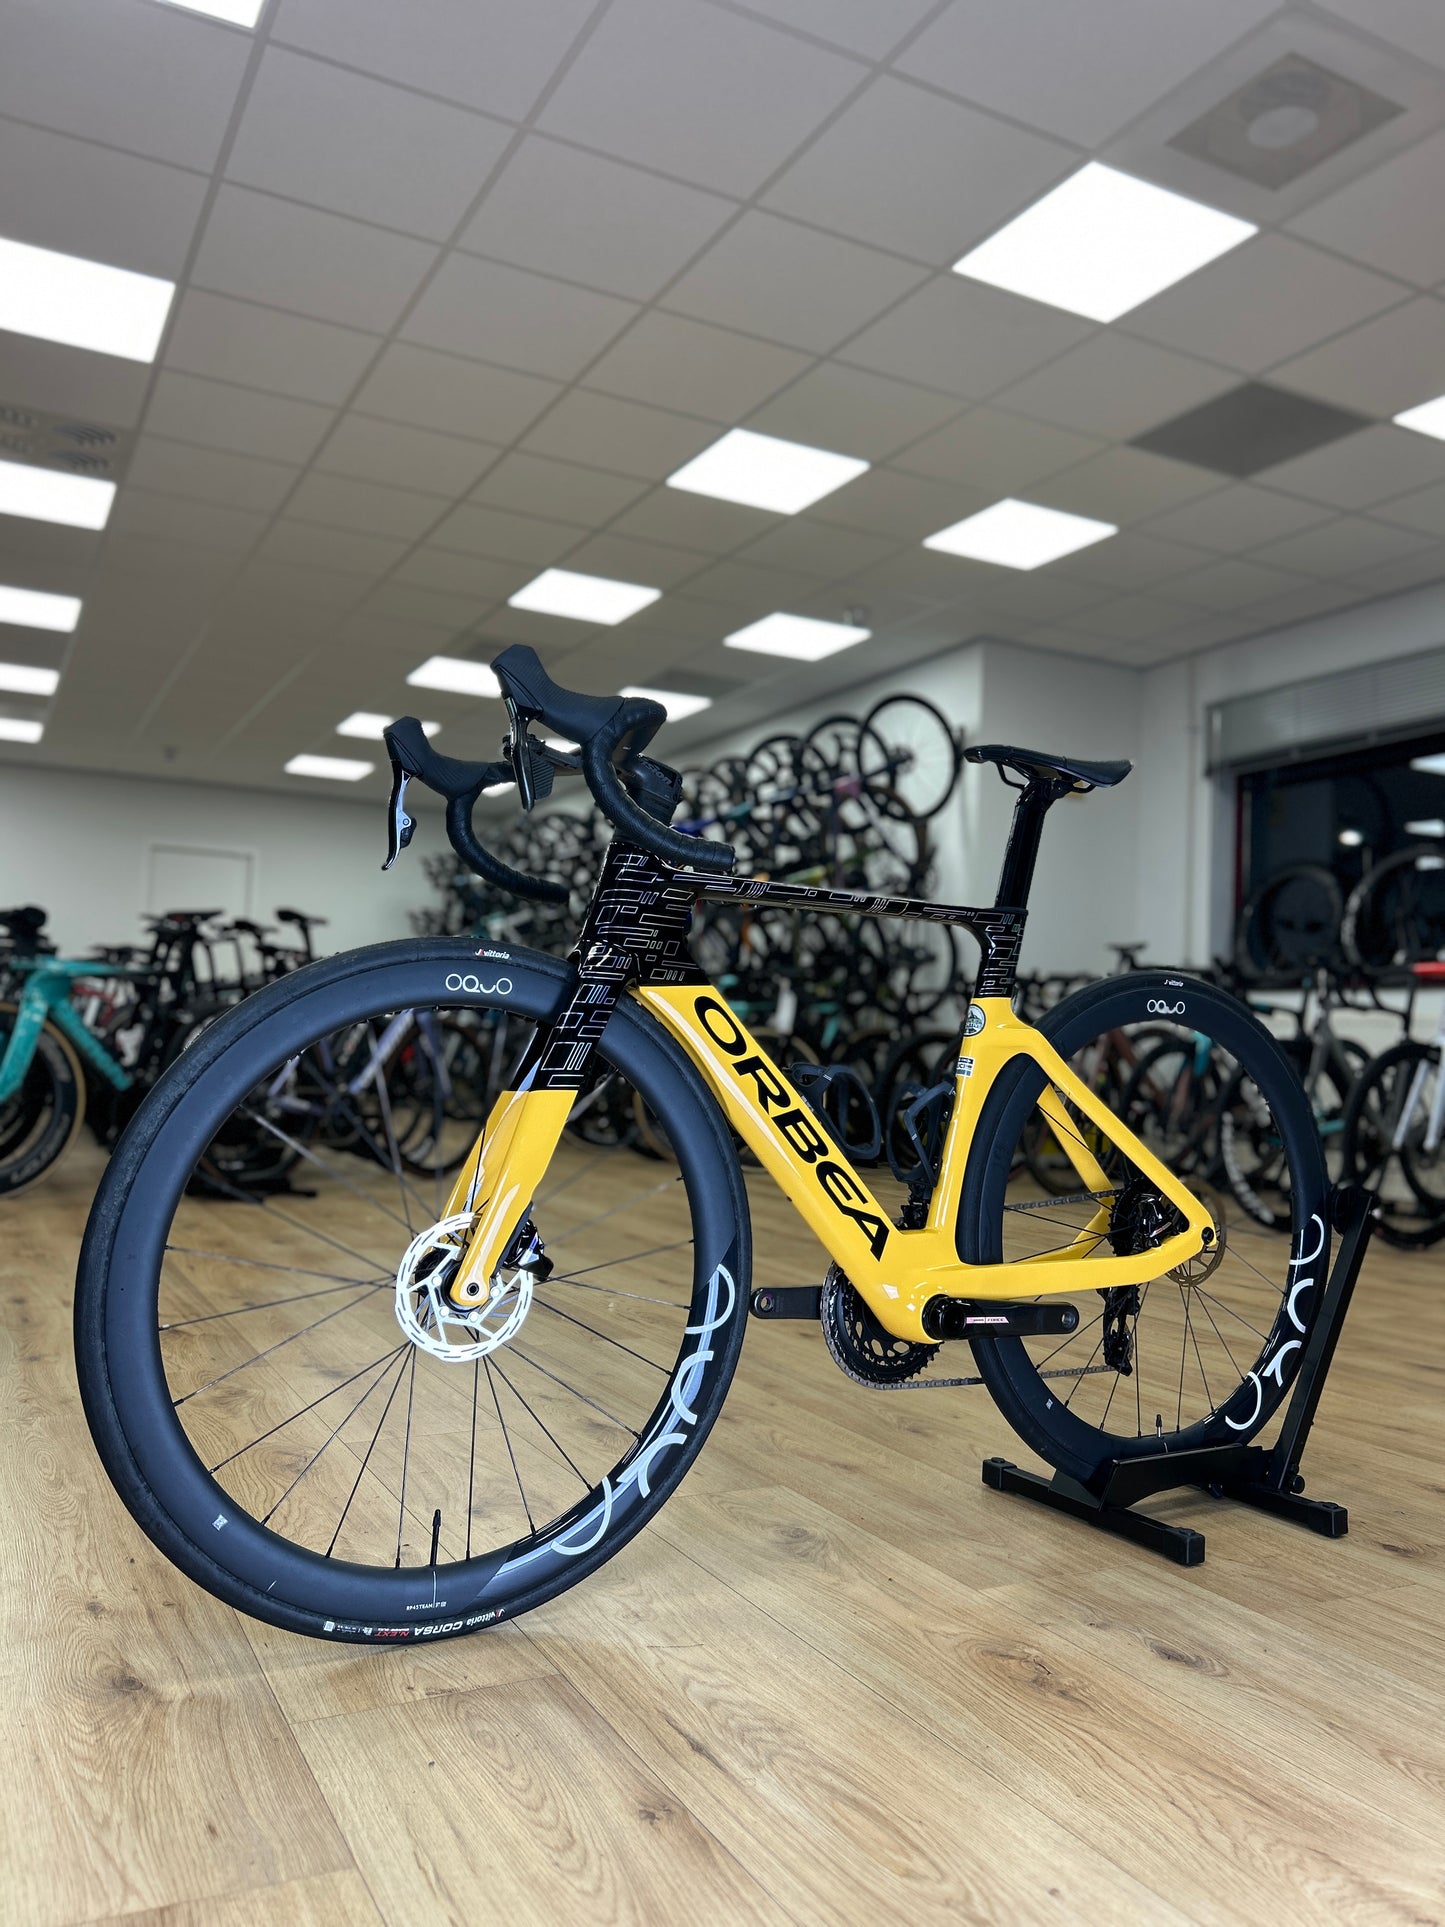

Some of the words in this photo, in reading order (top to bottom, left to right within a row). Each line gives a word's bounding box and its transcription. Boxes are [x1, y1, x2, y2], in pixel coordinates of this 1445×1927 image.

[693, 995, 890, 1262] ORBEA
[467, 1611, 496, 1626] vittoria
[414, 1620, 463, 1636] CORSA
